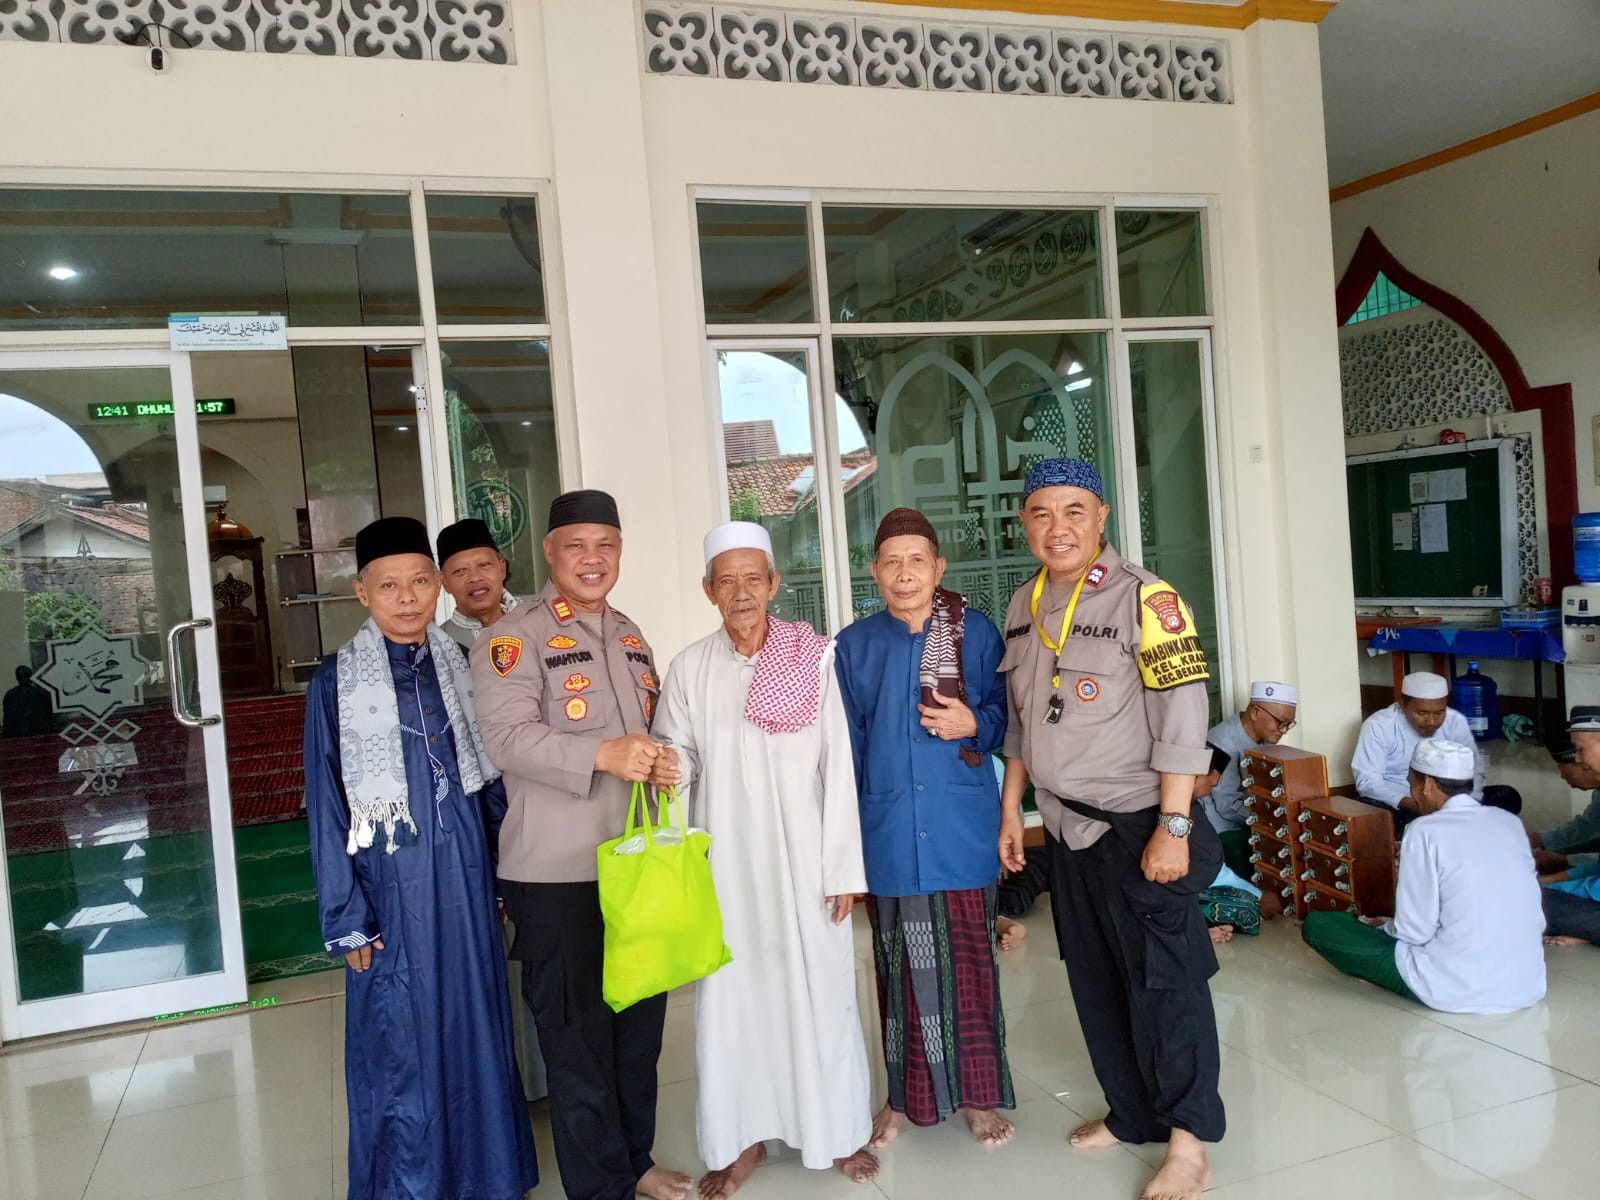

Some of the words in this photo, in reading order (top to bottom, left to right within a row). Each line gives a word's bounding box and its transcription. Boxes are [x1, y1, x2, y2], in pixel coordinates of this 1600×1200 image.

[96, 405, 129, 417] 12:41
[195, 402, 223, 412] 1:57
[1071, 624, 1118, 639] POLRI
[545, 651, 594, 669] WAHYUDI
